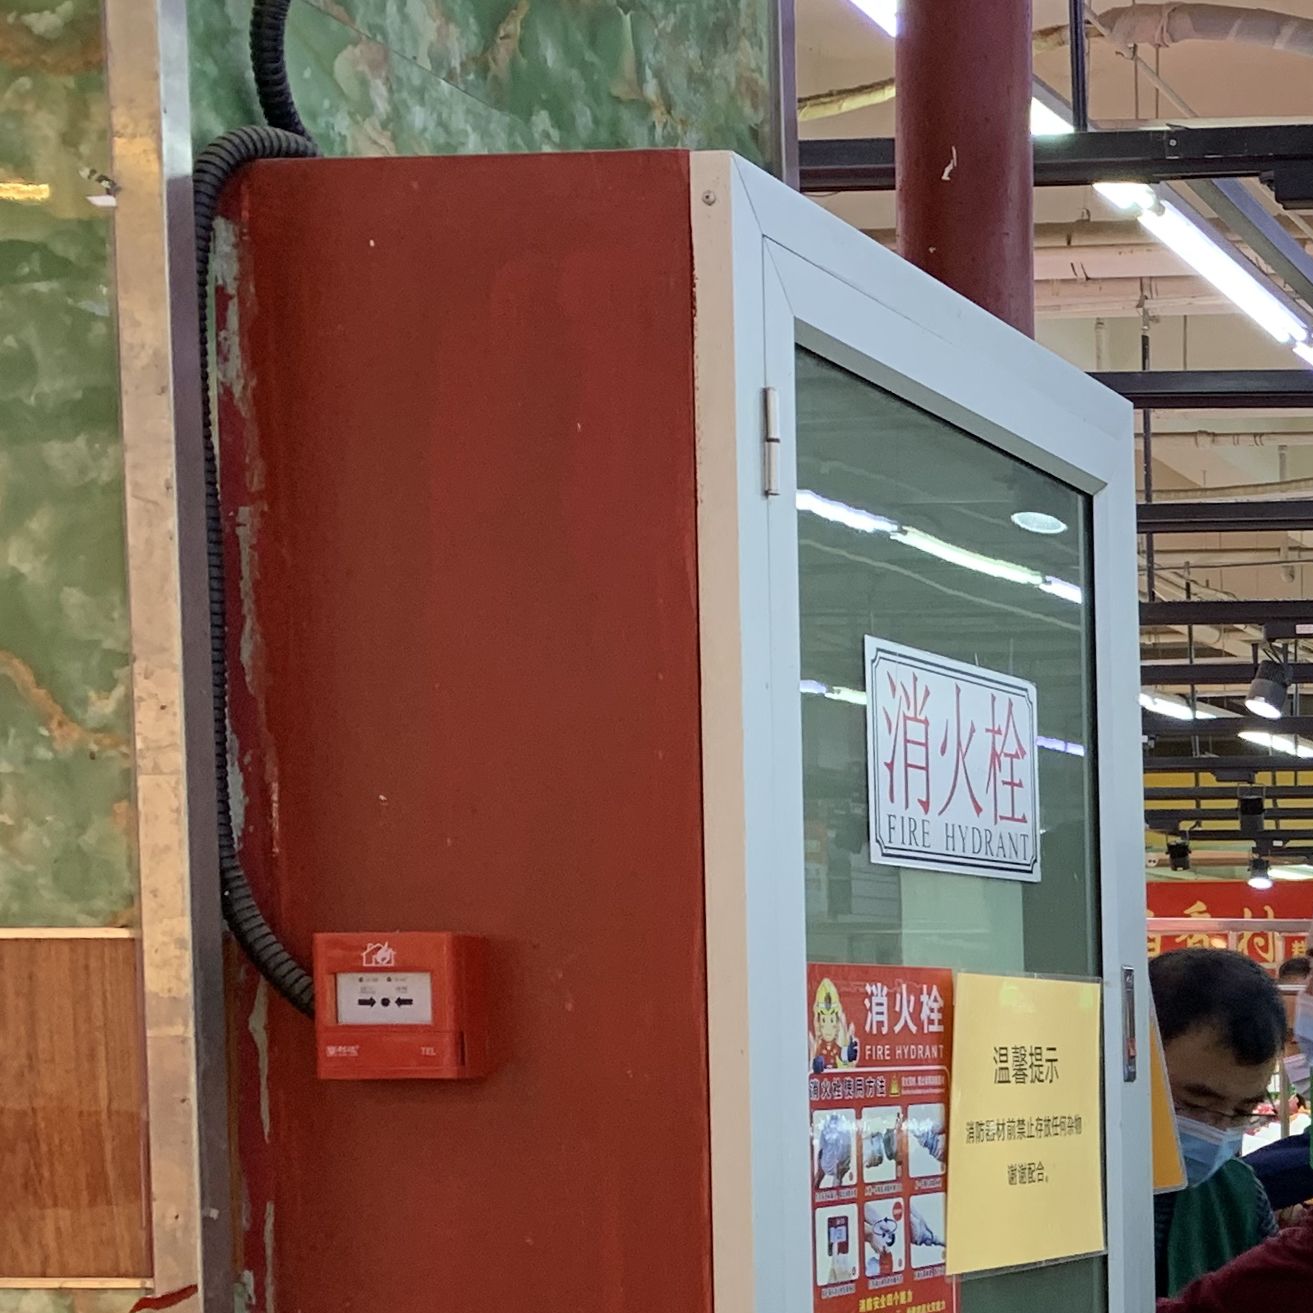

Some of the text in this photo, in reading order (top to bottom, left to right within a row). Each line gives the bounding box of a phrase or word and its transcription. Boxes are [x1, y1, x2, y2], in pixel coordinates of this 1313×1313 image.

[884, 671, 1028, 825] 消火栓
[887, 814, 1030, 861] FIRE HYDRANT
[863, 982, 945, 1035] 消火栓
[865, 1045, 944, 1060] FIRE HYDRANT
[993, 1045, 1060, 1085] 温馨提示
